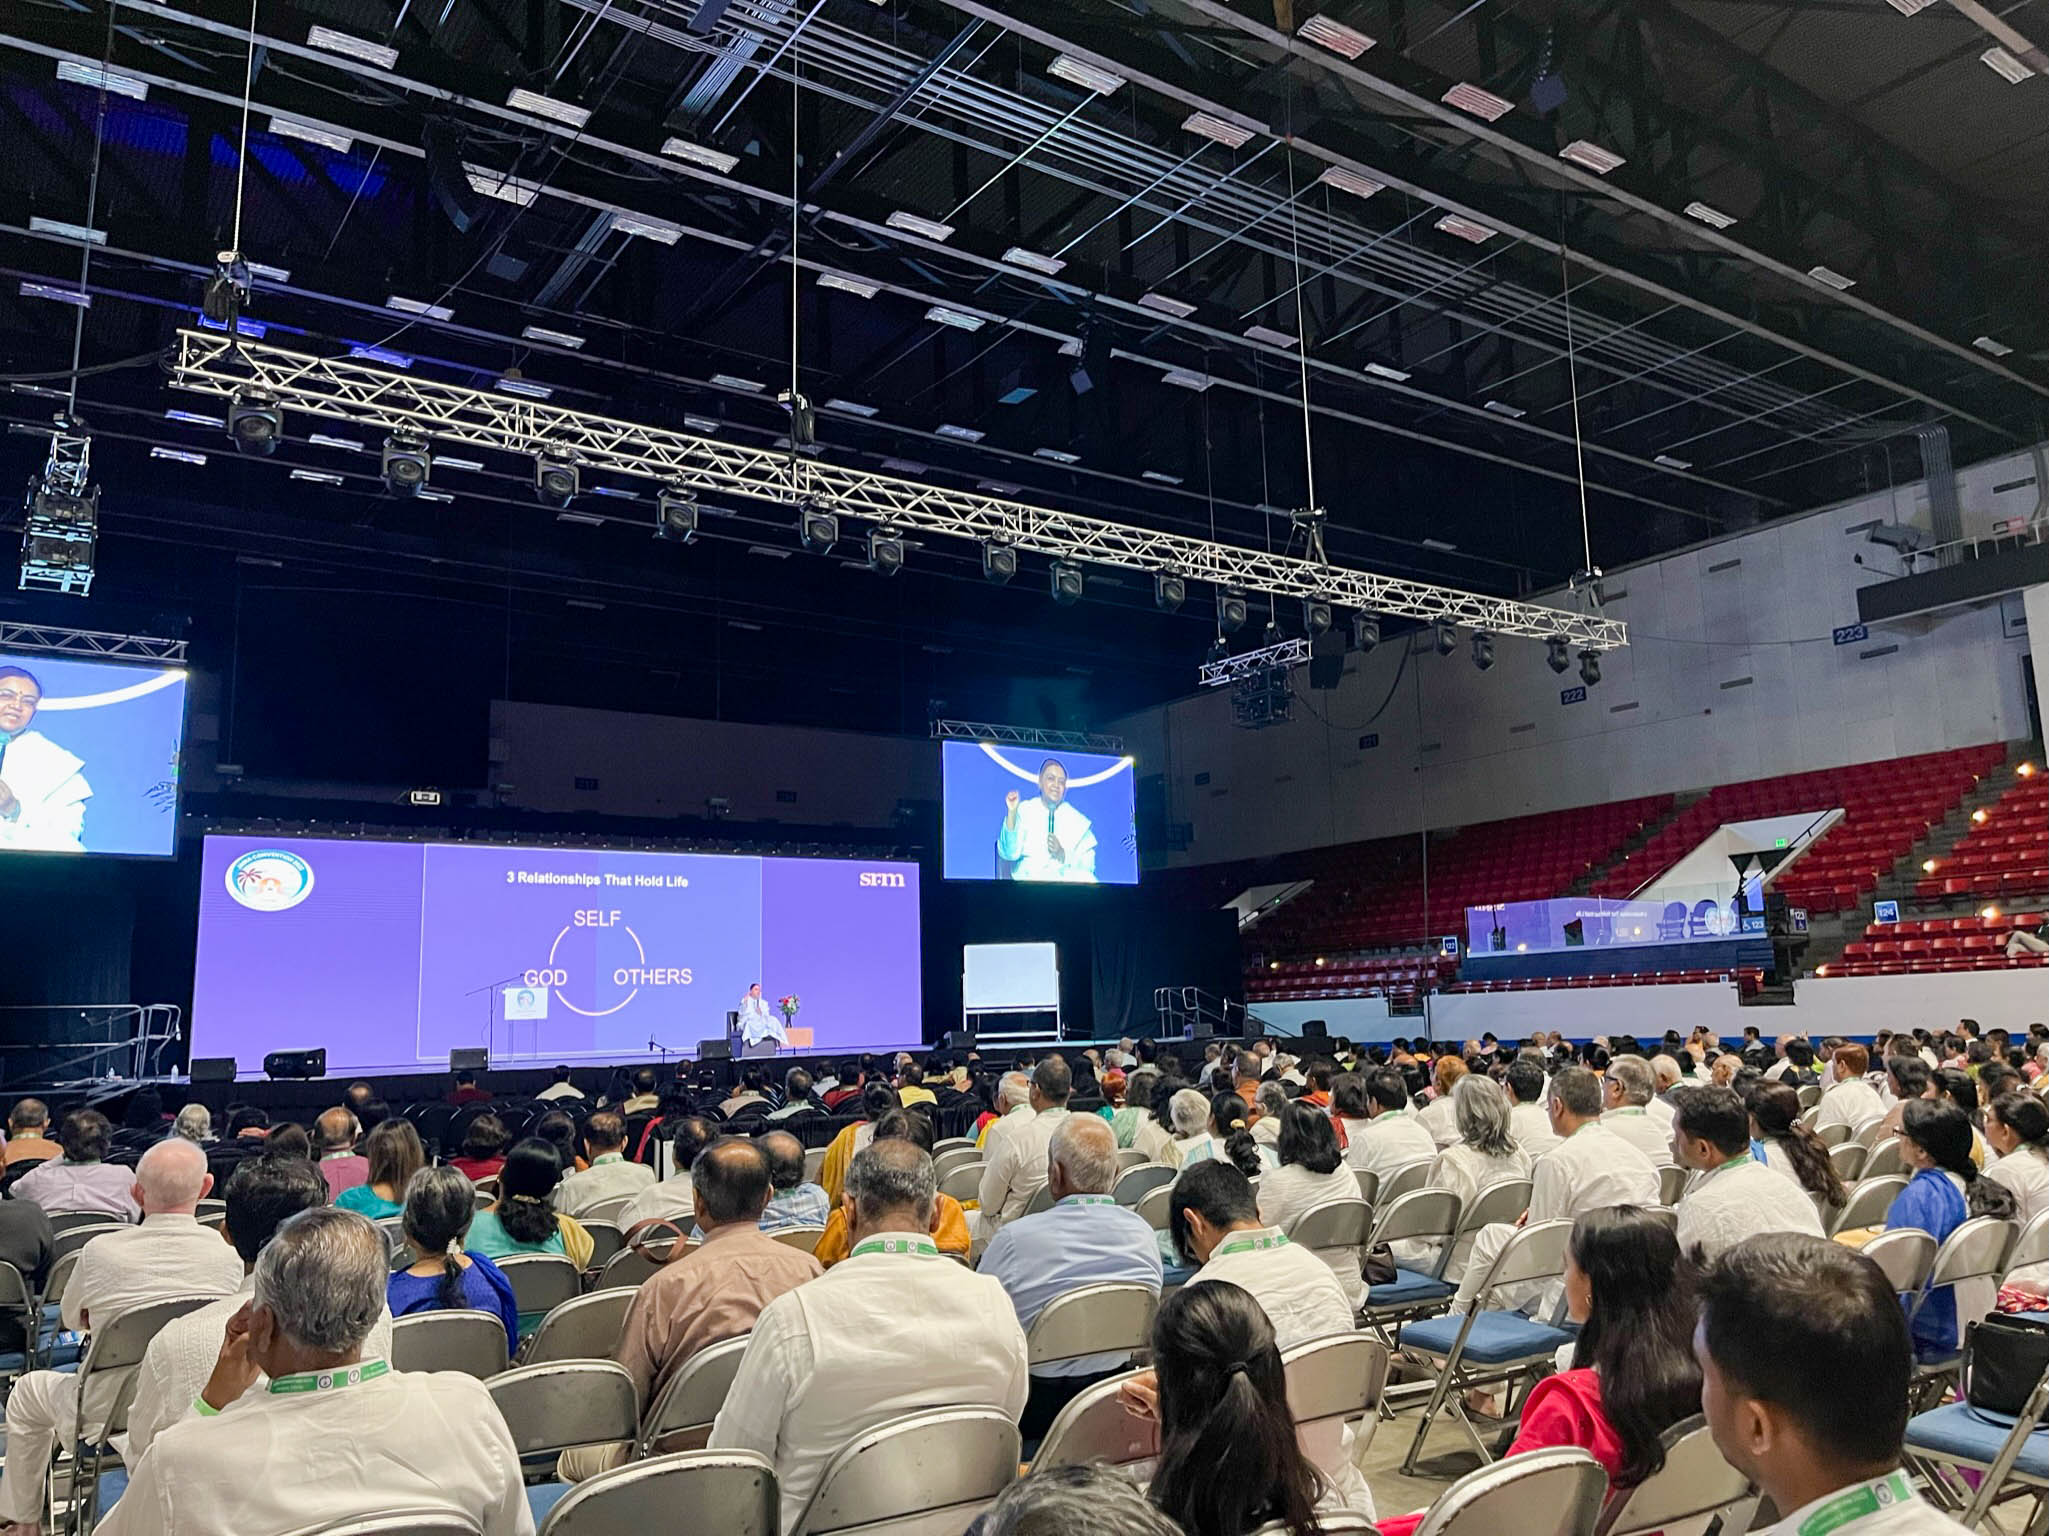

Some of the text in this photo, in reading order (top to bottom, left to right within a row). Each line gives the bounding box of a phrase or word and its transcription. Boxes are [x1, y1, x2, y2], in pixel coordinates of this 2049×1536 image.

[1836, 626, 1864, 643] 223
[1563, 689, 1585, 703] 222
[507, 871, 689, 888] 3 Relationships That Hold Life
[573, 910, 622, 927] SELF
[1878, 908, 1895, 918] 124
[1751, 920, 1764, 929] 123
[1445, 942, 1456, 950] 122
[524, 968, 693, 987] GOD OTHERS
